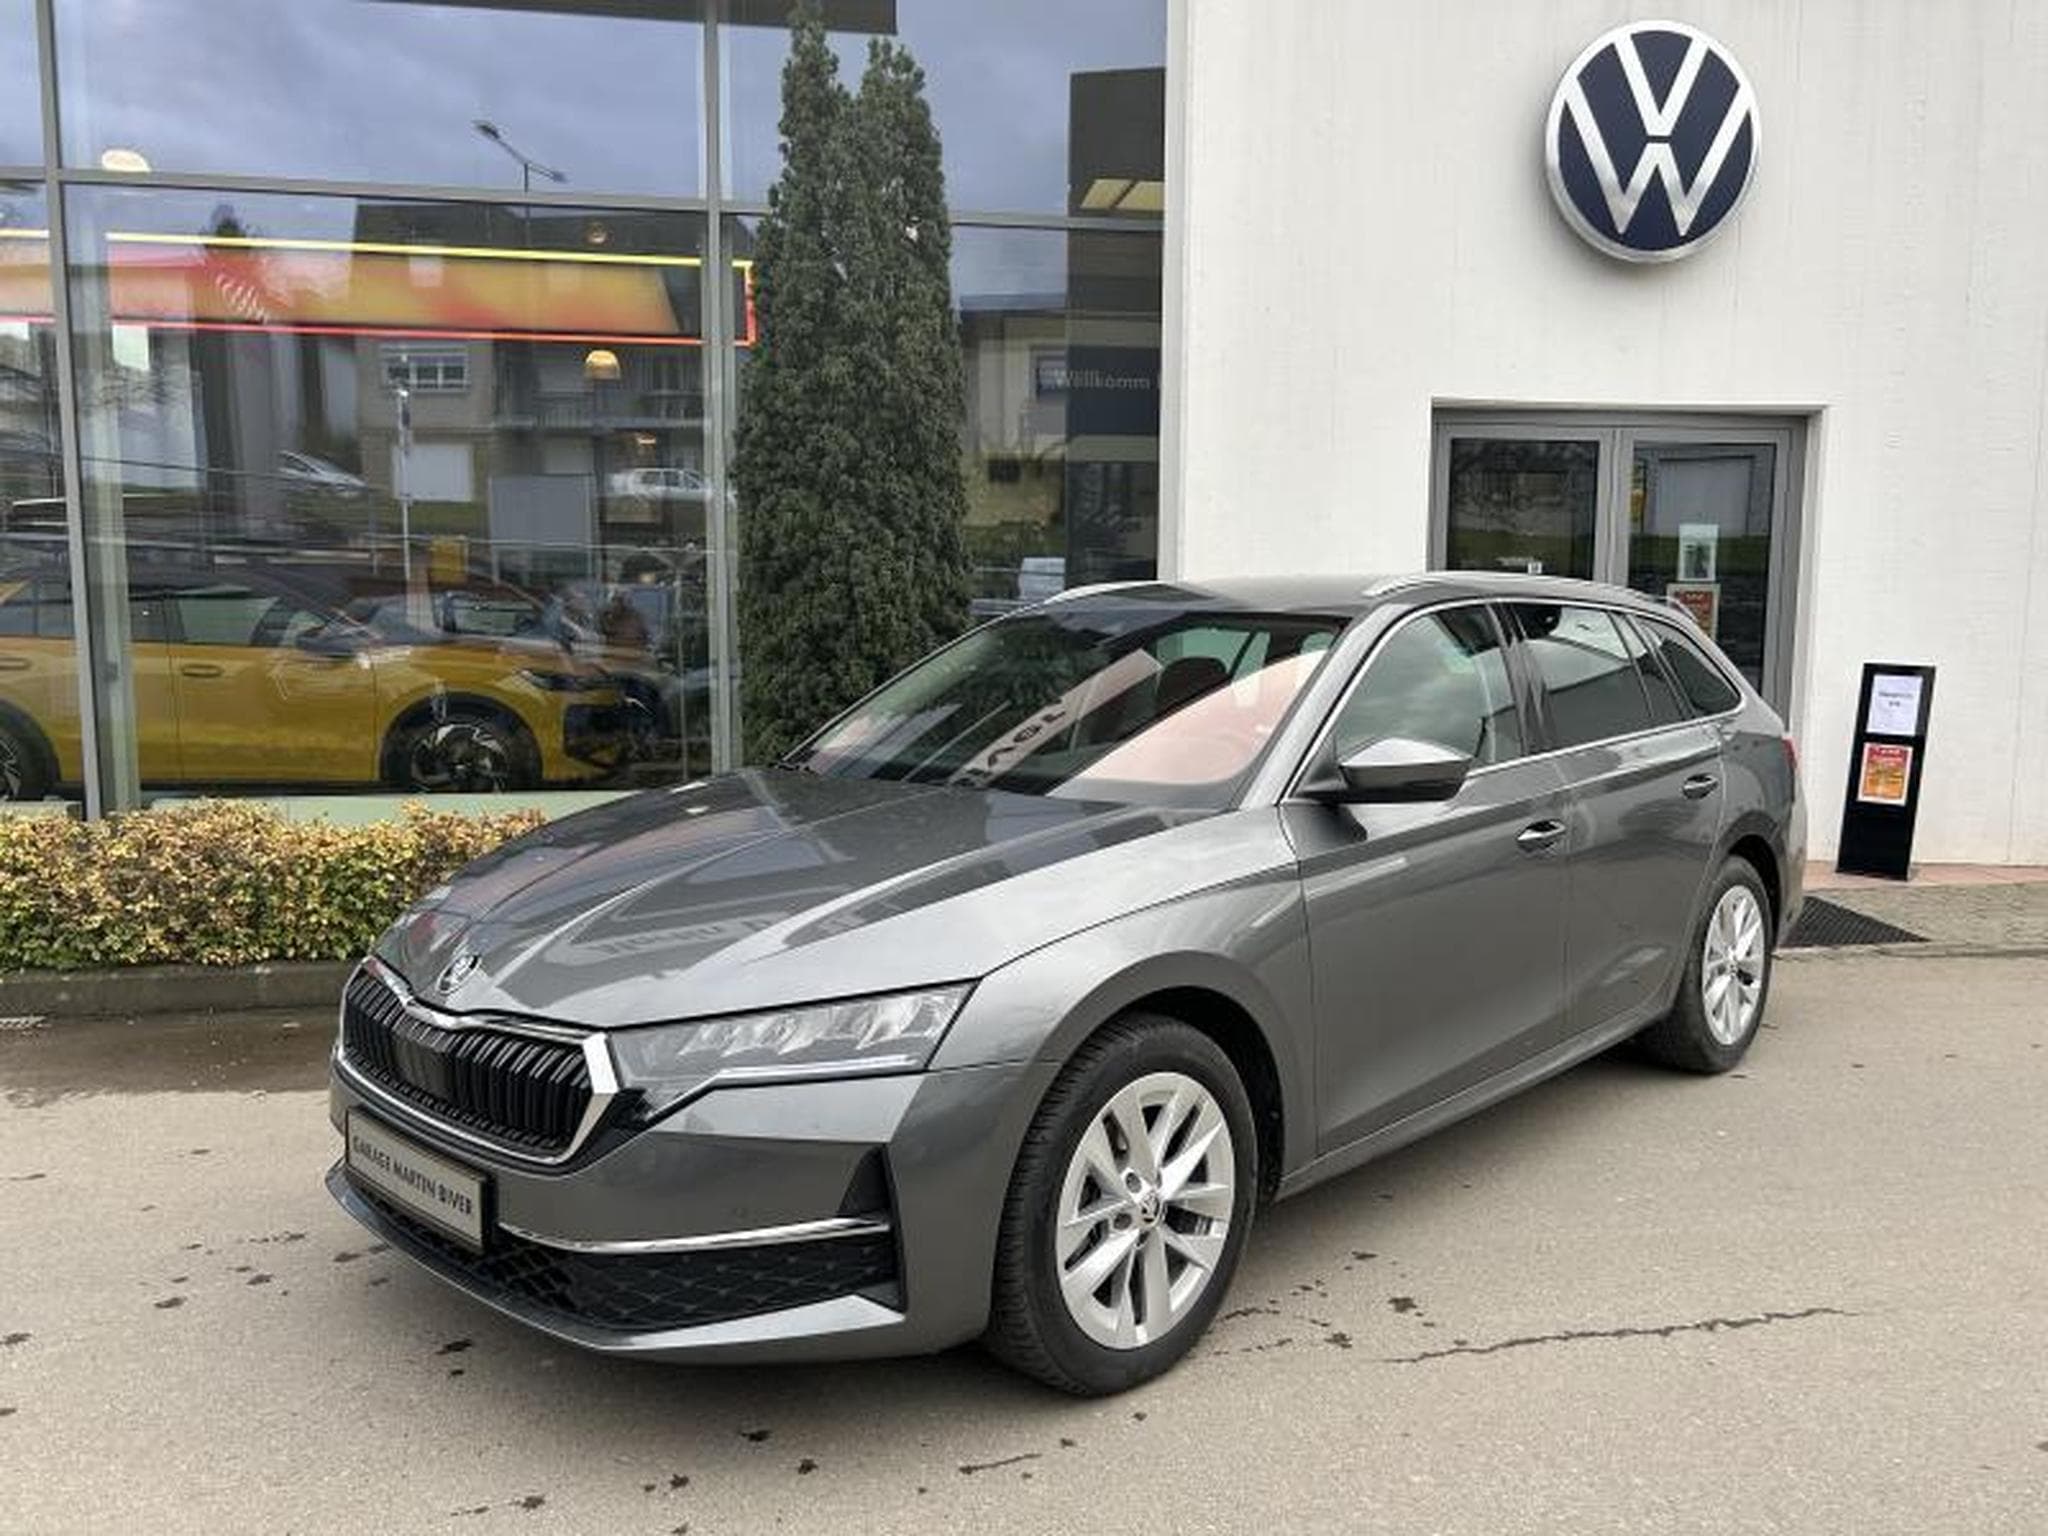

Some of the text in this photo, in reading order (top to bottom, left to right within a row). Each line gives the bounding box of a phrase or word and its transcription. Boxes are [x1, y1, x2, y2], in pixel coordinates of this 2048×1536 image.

[1556, 28, 1755, 240] VW
[352, 1135, 391, 1172] GARAGE
[393, 1159, 436, 1198] MARTIN
